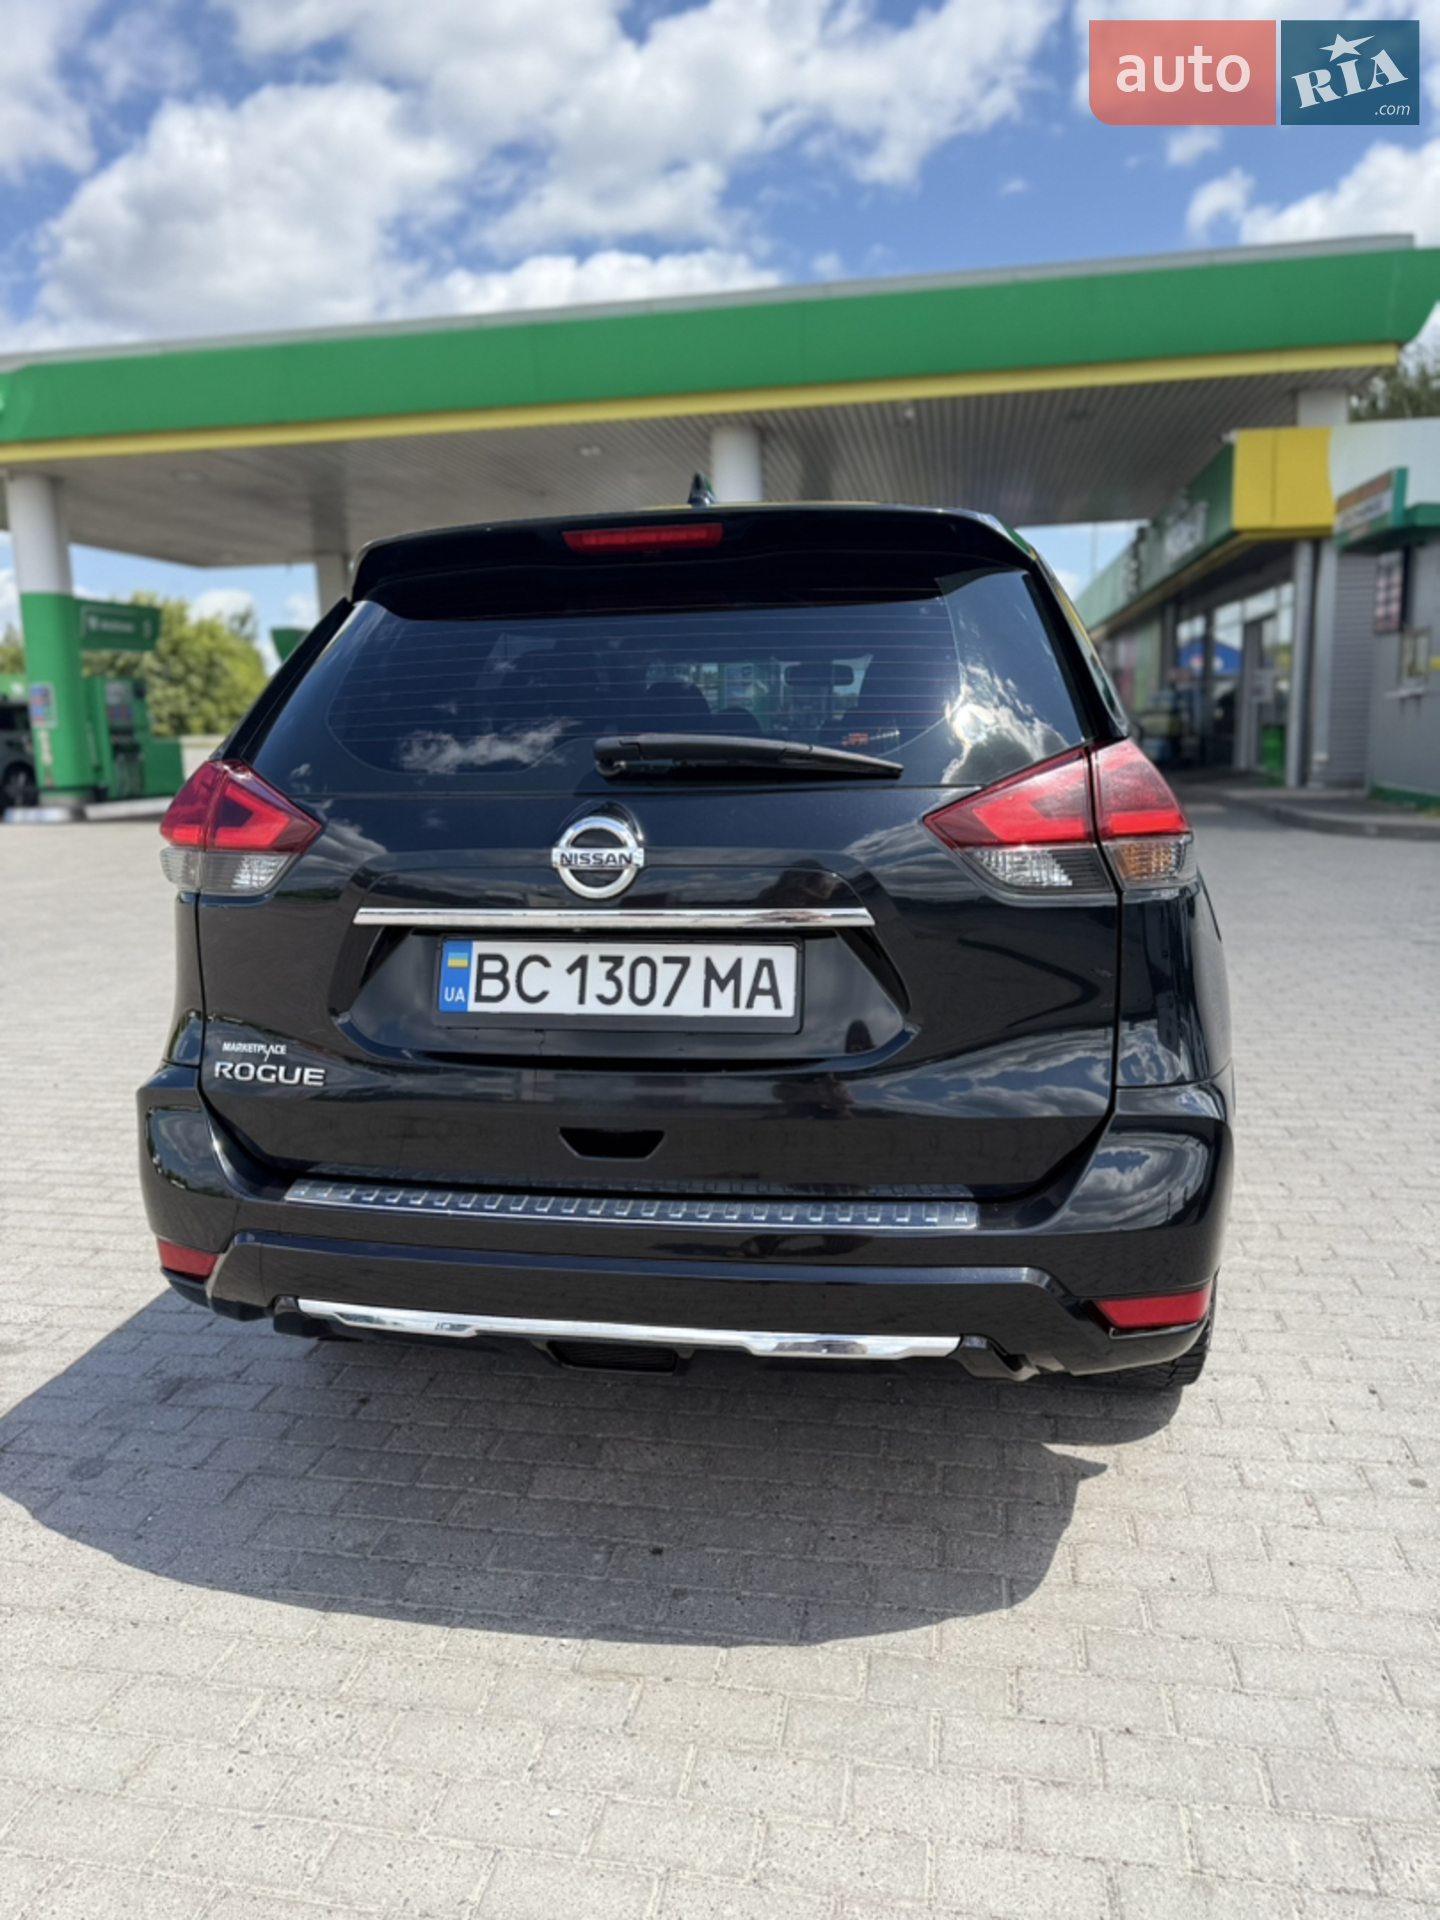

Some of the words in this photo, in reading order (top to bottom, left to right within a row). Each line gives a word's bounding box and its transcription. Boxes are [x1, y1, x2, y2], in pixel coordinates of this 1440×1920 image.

[560, 852, 633, 867] NISSAN
[474, 953, 552, 1004] BC
[565, 954, 691, 1007] 1307
[703, 957, 782, 1010] MA
[444, 986, 466, 1003] UA
[214, 1061, 326, 1086] ROGUE
